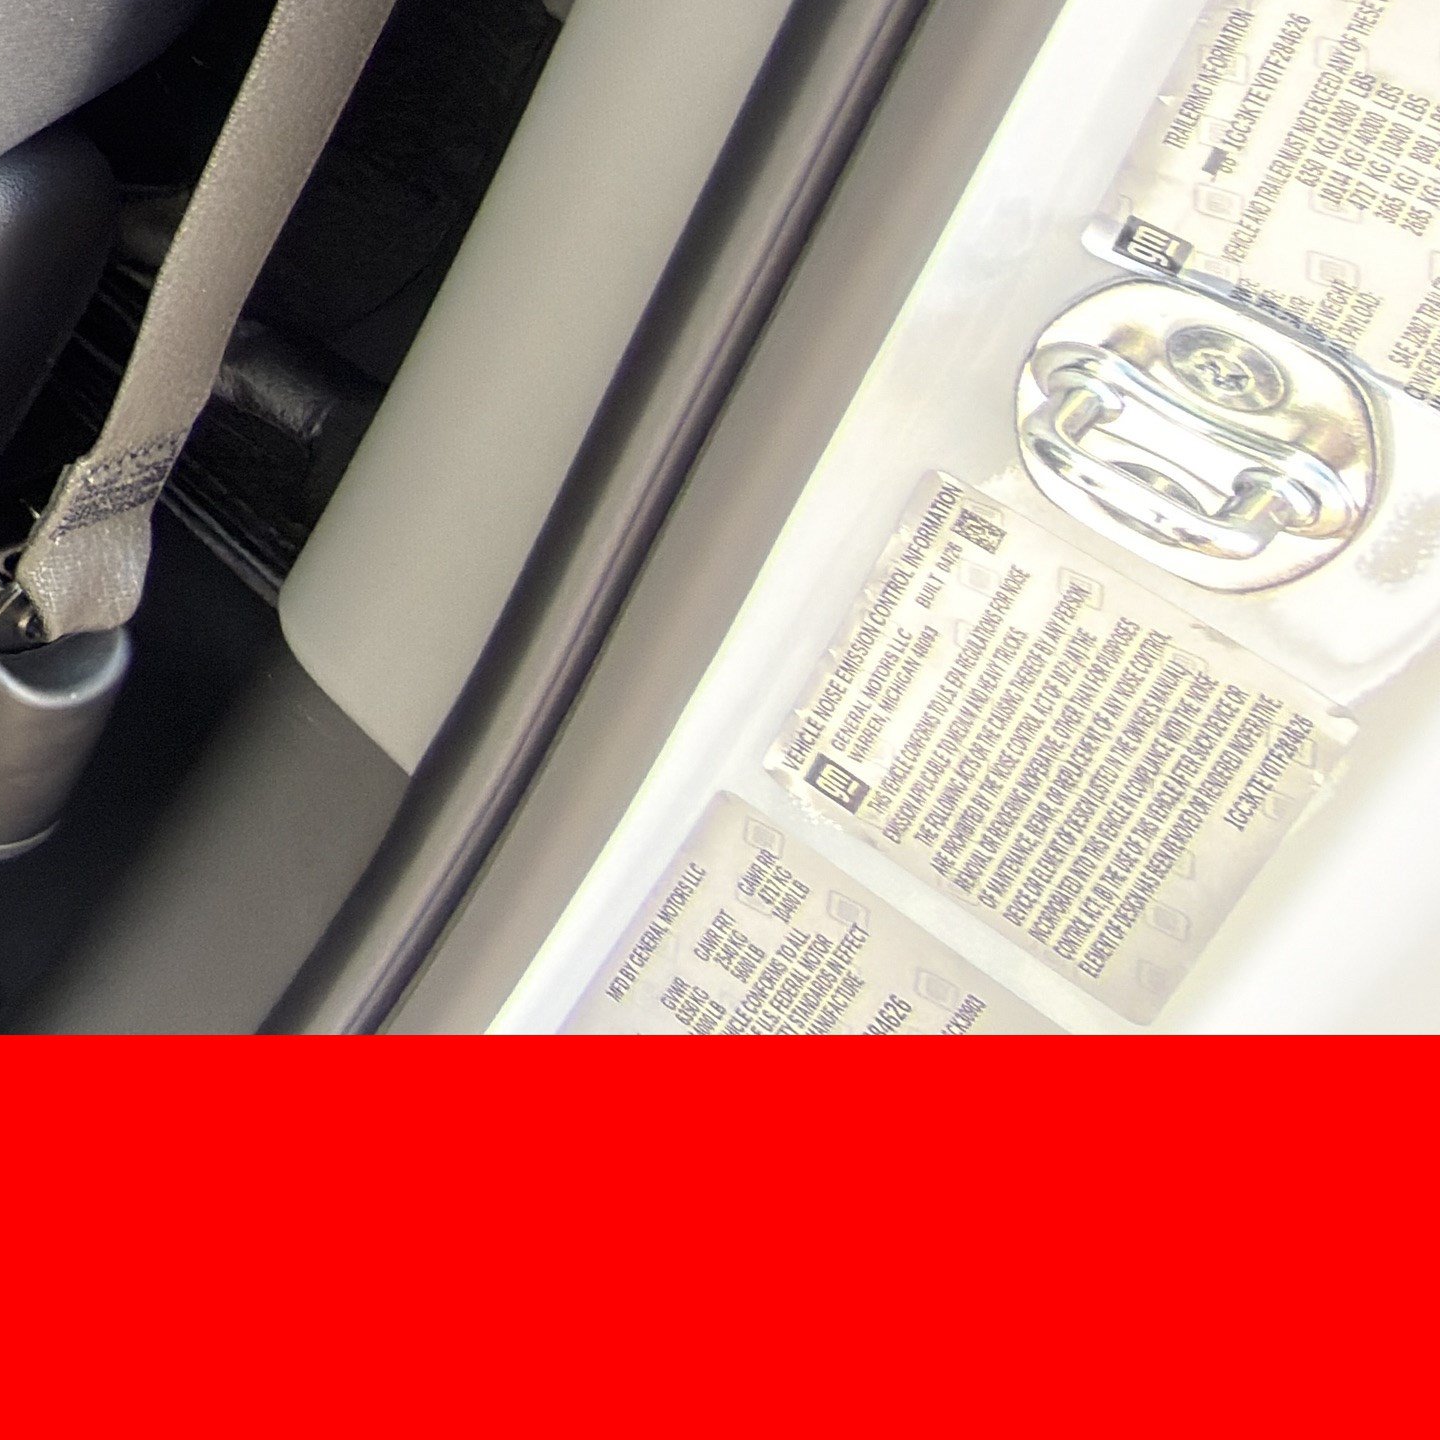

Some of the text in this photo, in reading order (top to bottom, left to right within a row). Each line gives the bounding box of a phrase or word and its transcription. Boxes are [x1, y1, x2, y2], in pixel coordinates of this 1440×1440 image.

[1325, 47, 1357, 75] ANY
[1337, 32, 1365, 53] OF
[1163, 5, 1255, 151] TRAILERING INFORMATION
[1303, 69, 1345, 116] EXCEED
[1371, 79, 1406, 112] LBS
[1291, 109, 1322, 136] NOT
[1294, 156, 1328, 189] 6350
[1344, 68, 1378, 100] LBS
[1276, 130, 1311, 164] MUST
[1345, 179, 1381, 213] 4717
[1397, 90, 1432, 123] LBS
[1254, 158, 1295, 204] TRAILER
[1242, 198, 1272, 225] AND
[1372, 191, 1408, 225] 3665
[1398, 203, 1435, 238] 2685
[1124, 222, 1180, 269] gm
[1220, 219, 1260, 265] VEHICLE
[1337, 287, 1384, 340] PAYLOAD:
[1386, 341, 1420, 369] SAE
[913, 571, 946, 610] BUILT
[781, 480, 963, 773] VEHICLE NOISE EMISSION CONTROL INFORMATION
[1094, 614, 1141, 670] PURPOSES
[829, 626, 914, 753] GENERAL MOTORS LLC
[867, 563, 1031, 816] THIS VEHICLE CONFORMS TO U.S. EPA REGULATIONS FOR NOISE
[974, 658, 1008, 695] HEAVY
[1068, 679, 1100, 711] THAN
[1082, 660, 1111, 688] FOR
[847, 709, 891, 766] WARREN,
[877, 655, 921, 714] MICHIGAN
[914, 580, 1091, 848] THE FOLLOWING ACTS OR THE CAUSING THEREOF BY ANY PERSON
[963, 685, 991, 713] AND
[1049, 702, 1085, 741] OTHER
[936, 735, 960, 757] TO
[814, 761, 860, 805] gm
[905, 748, 952, 807] APPLICABLE
[1221, 711, 1316, 832] 1GC3KTEY0TF284626
[881, 797, 921, 845] EMISSION
[985, 785, 1032, 842] RENDERING
[977, 832, 1002, 855] OR
[952, 846, 993, 894] REMOVAL
[604, 861, 707, 1003] MFD BY GENERAL MOTORS LLC
[658, 847, 780, 1011] GVWR GAWR FRT GAWR RR
[673, 864, 794, 1027] 6350 KG 2540 KG 4717 KG
[704, 999, 728, 1020] LB
[744, 942, 767, 964] LB
[771, 891, 802, 924] 10400
[788, 878, 812, 899] LB
[740, 924, 811, 1016] CONFORMS TO ALL
[754, 931, 835, 1033] U.S. FEDERAL MOTOR
[785, 920, 872, 1030] STANDARDS IN EFFECT
